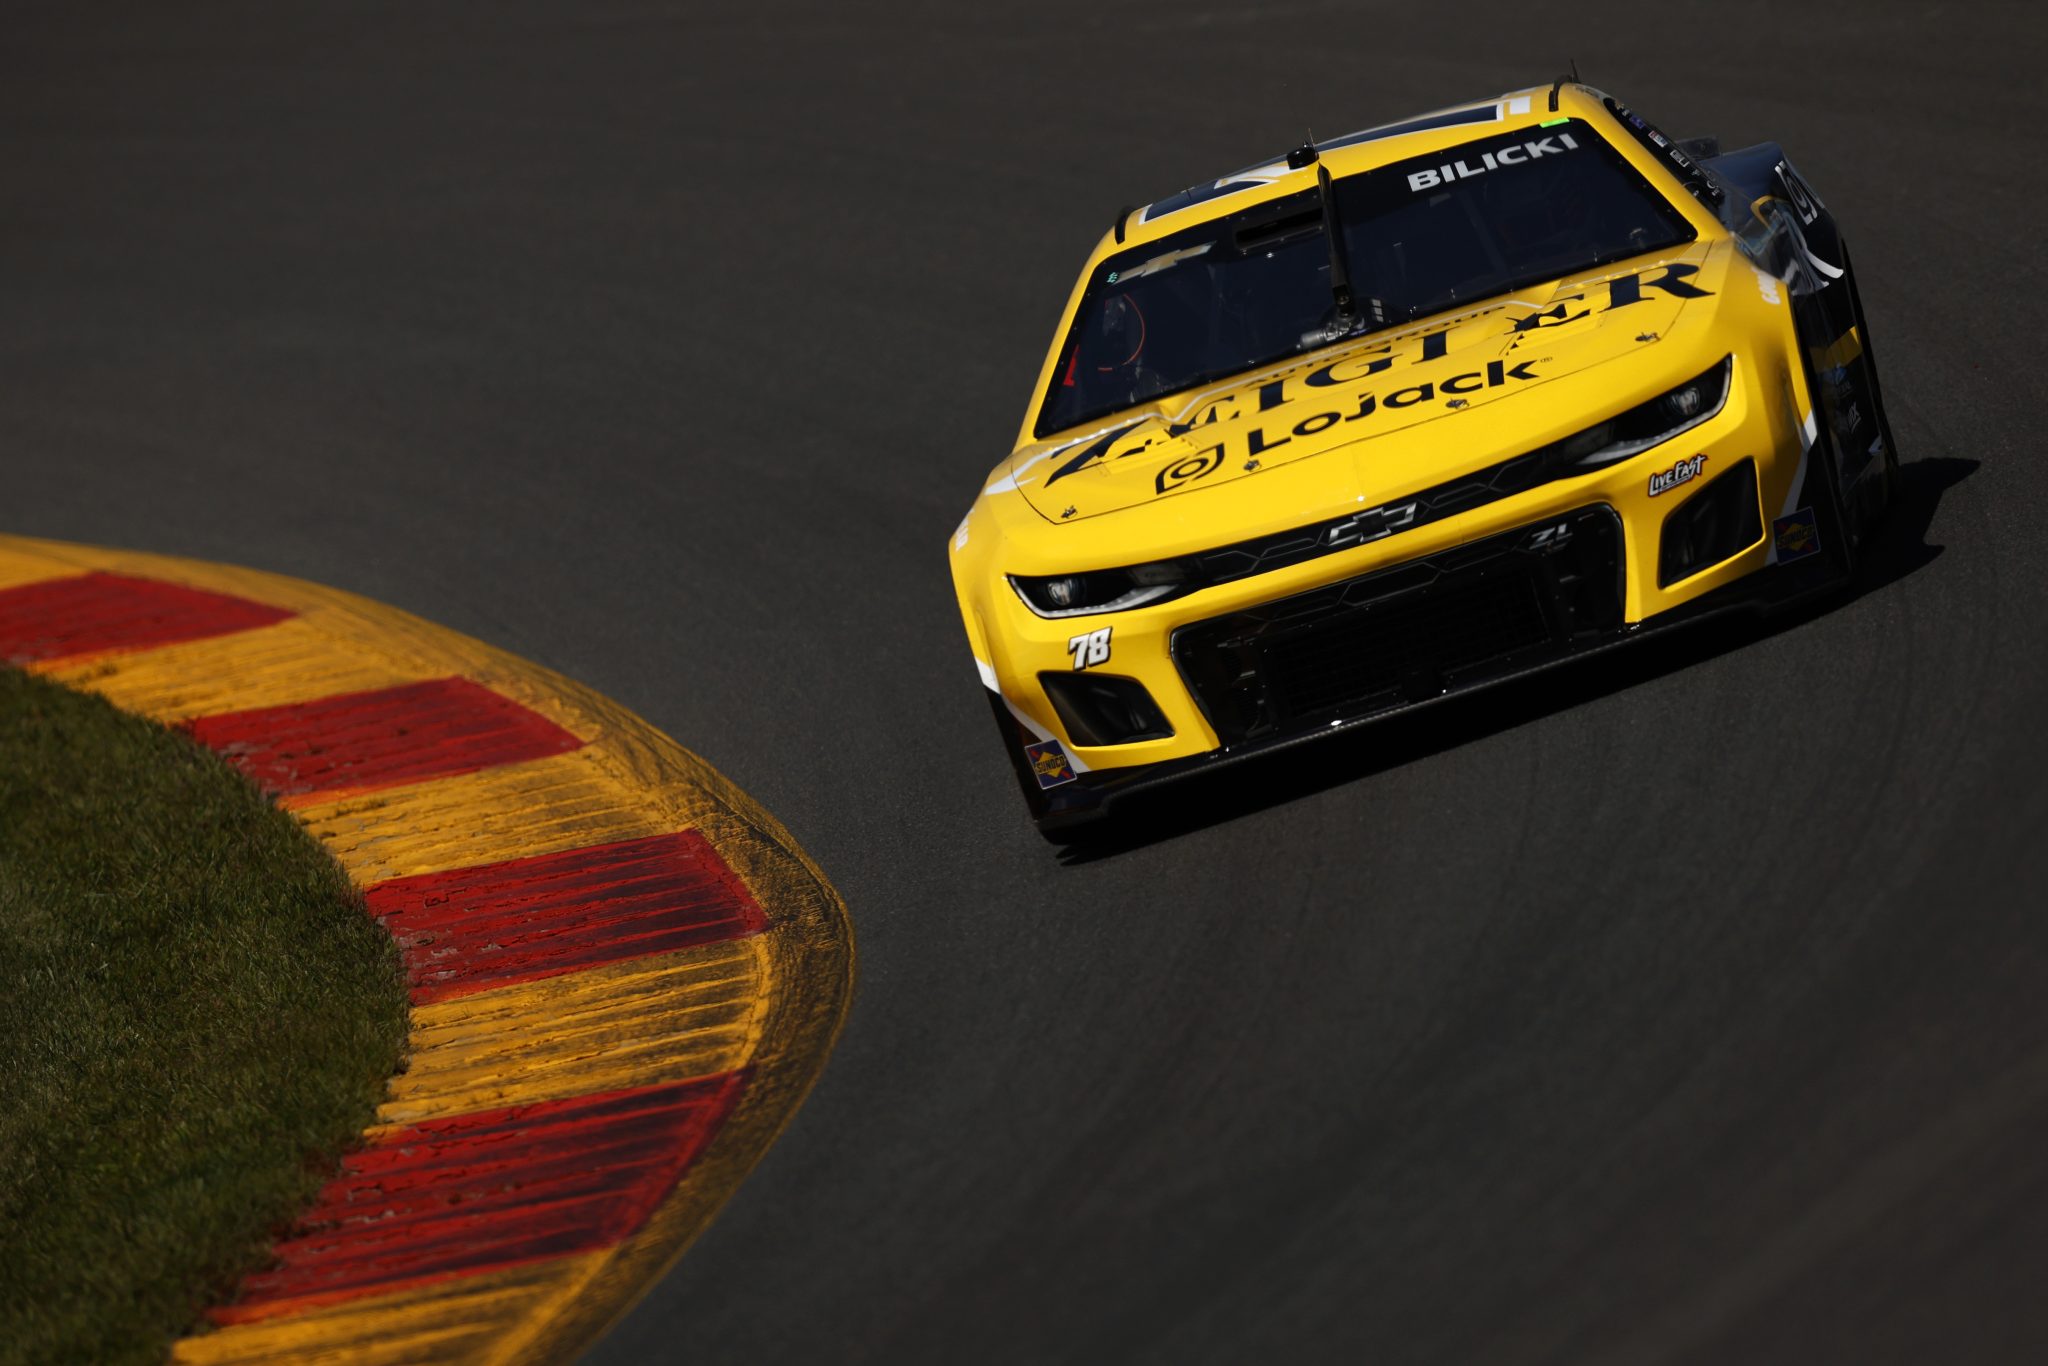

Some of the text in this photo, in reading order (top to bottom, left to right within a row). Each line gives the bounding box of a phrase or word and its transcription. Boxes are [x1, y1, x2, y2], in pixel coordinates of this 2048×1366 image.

[1408, 133, 1579, 192] BILICKI
[1068, 627, 1113, 671] 78
[1034, 756, 1068, 776] SUNOCO
